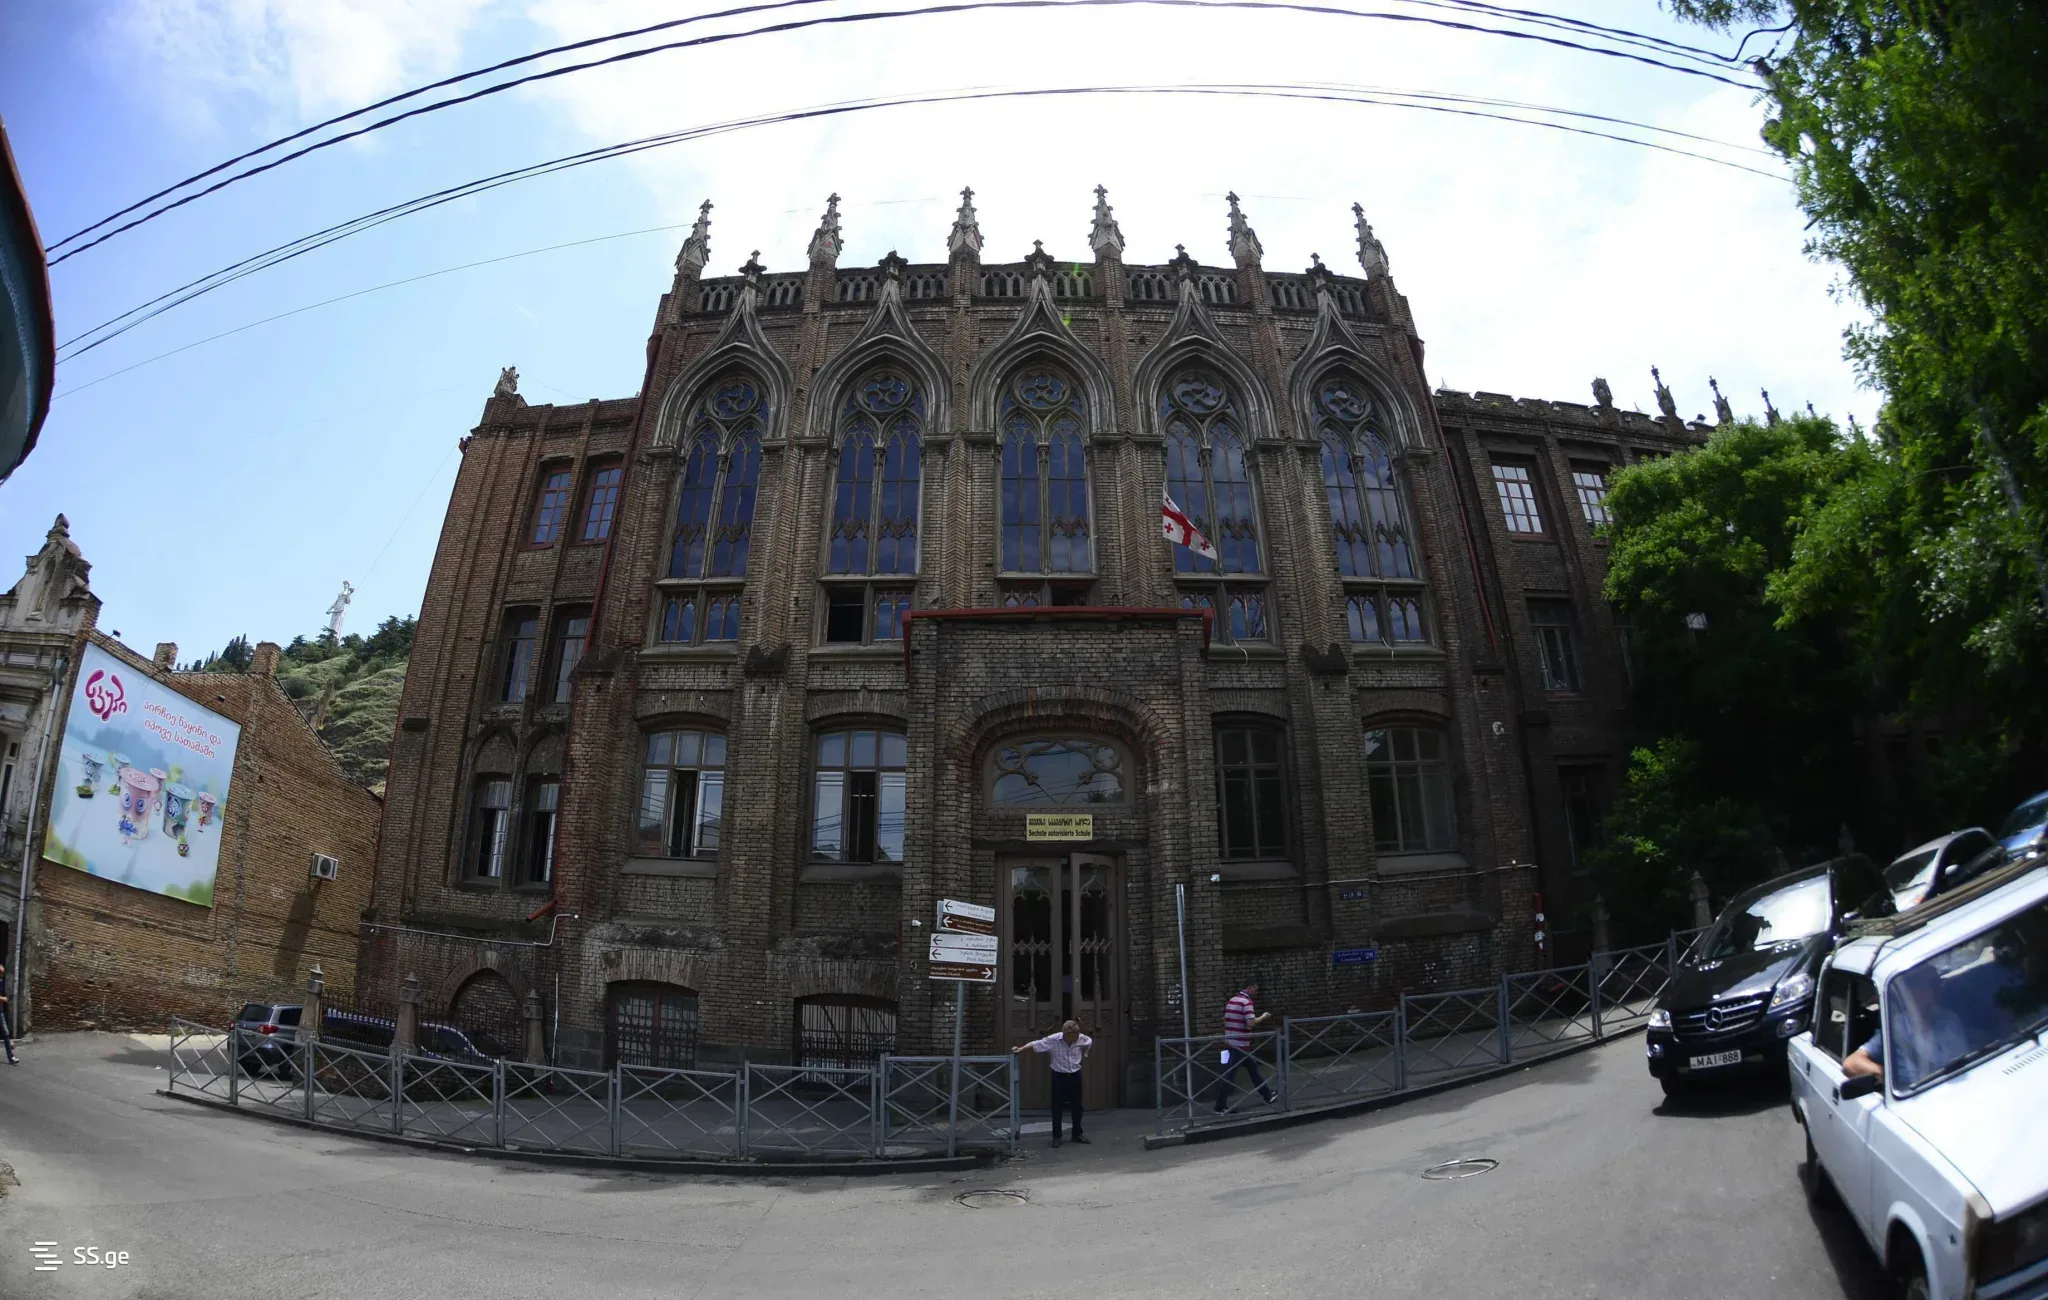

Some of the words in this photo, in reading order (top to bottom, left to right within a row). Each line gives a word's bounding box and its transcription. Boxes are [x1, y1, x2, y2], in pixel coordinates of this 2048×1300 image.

[144, 700, 177, 726] აირჩიე
[178, 715, 208, 738] ნაყინი
[209, 733, 222, 745] და
[144, 719, 172, 742] იპოვე
[174, 730, 216, 759] სათამაშო
[1028, 829, 1047, 837] Sechste
[1048, 829, 1074, 837] autorisierte
[1075, 829, 1091, 837] Schule
